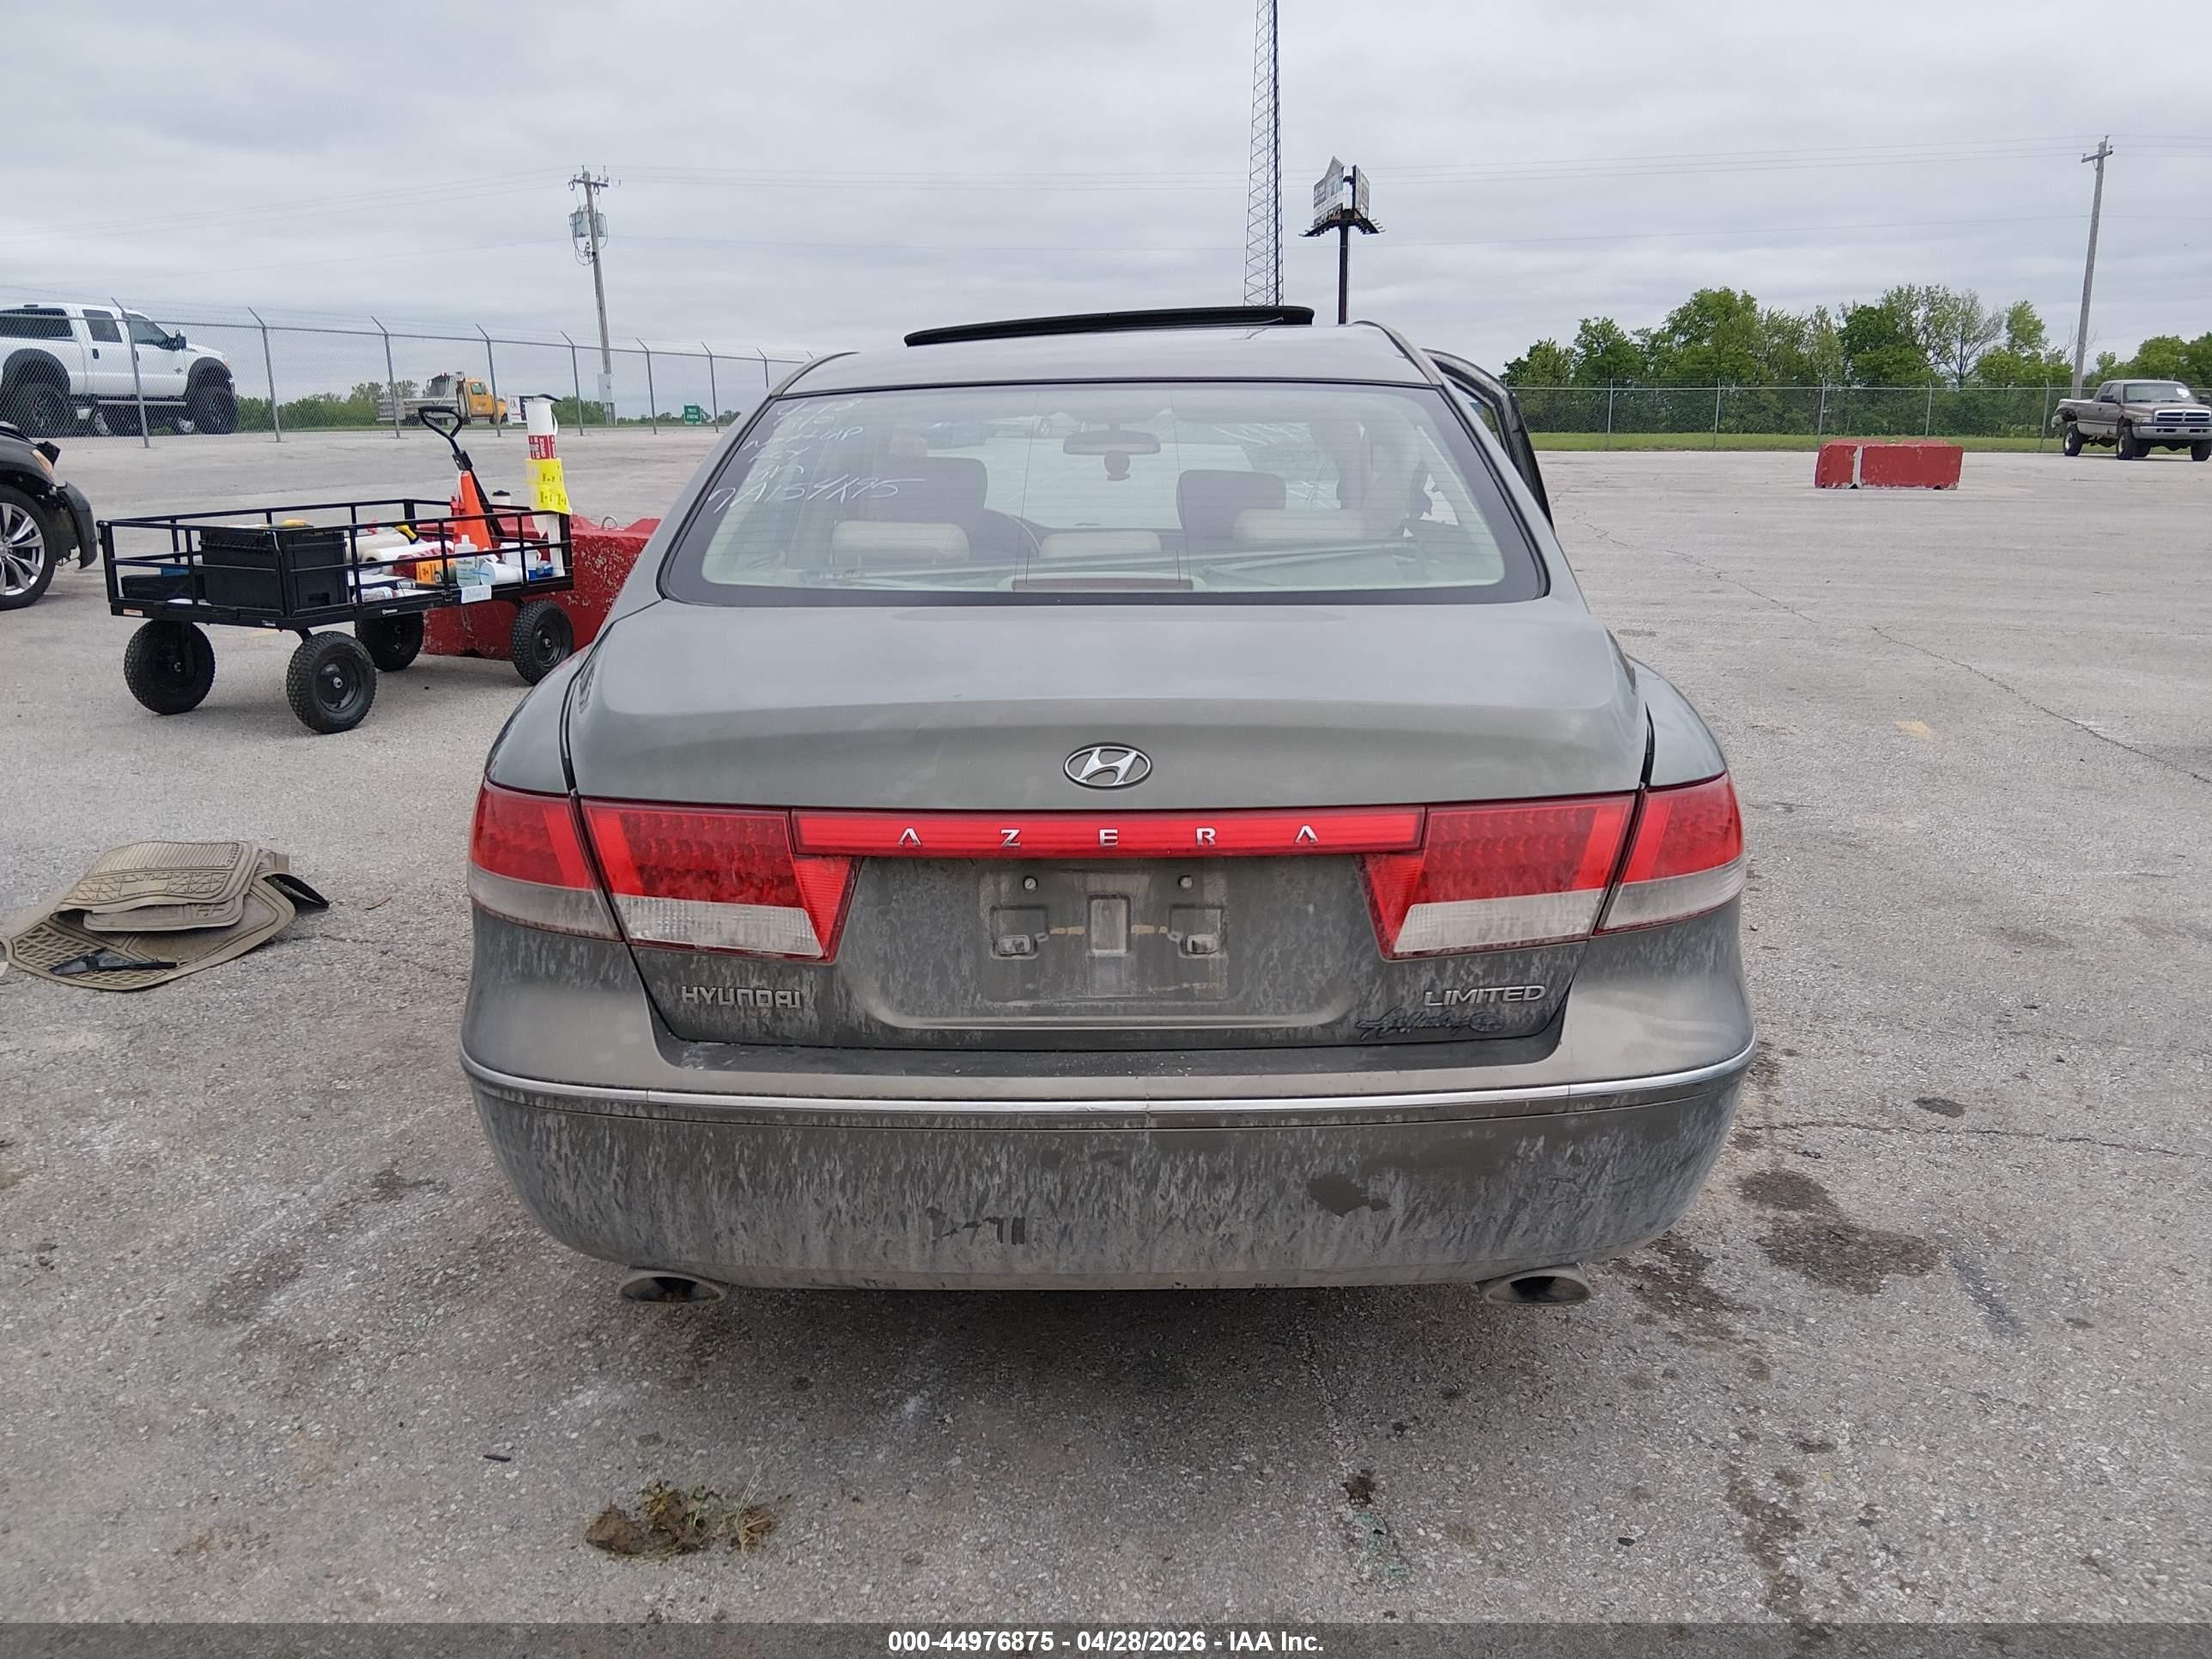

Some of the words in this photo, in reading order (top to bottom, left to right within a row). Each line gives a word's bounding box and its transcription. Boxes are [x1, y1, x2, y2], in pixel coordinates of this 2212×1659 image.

[898, 827, 1319, 847] AZERA
[681, 986, 802, 1009] HYUNDAI
[1424, 985, 1547, 1006] LIMITED
